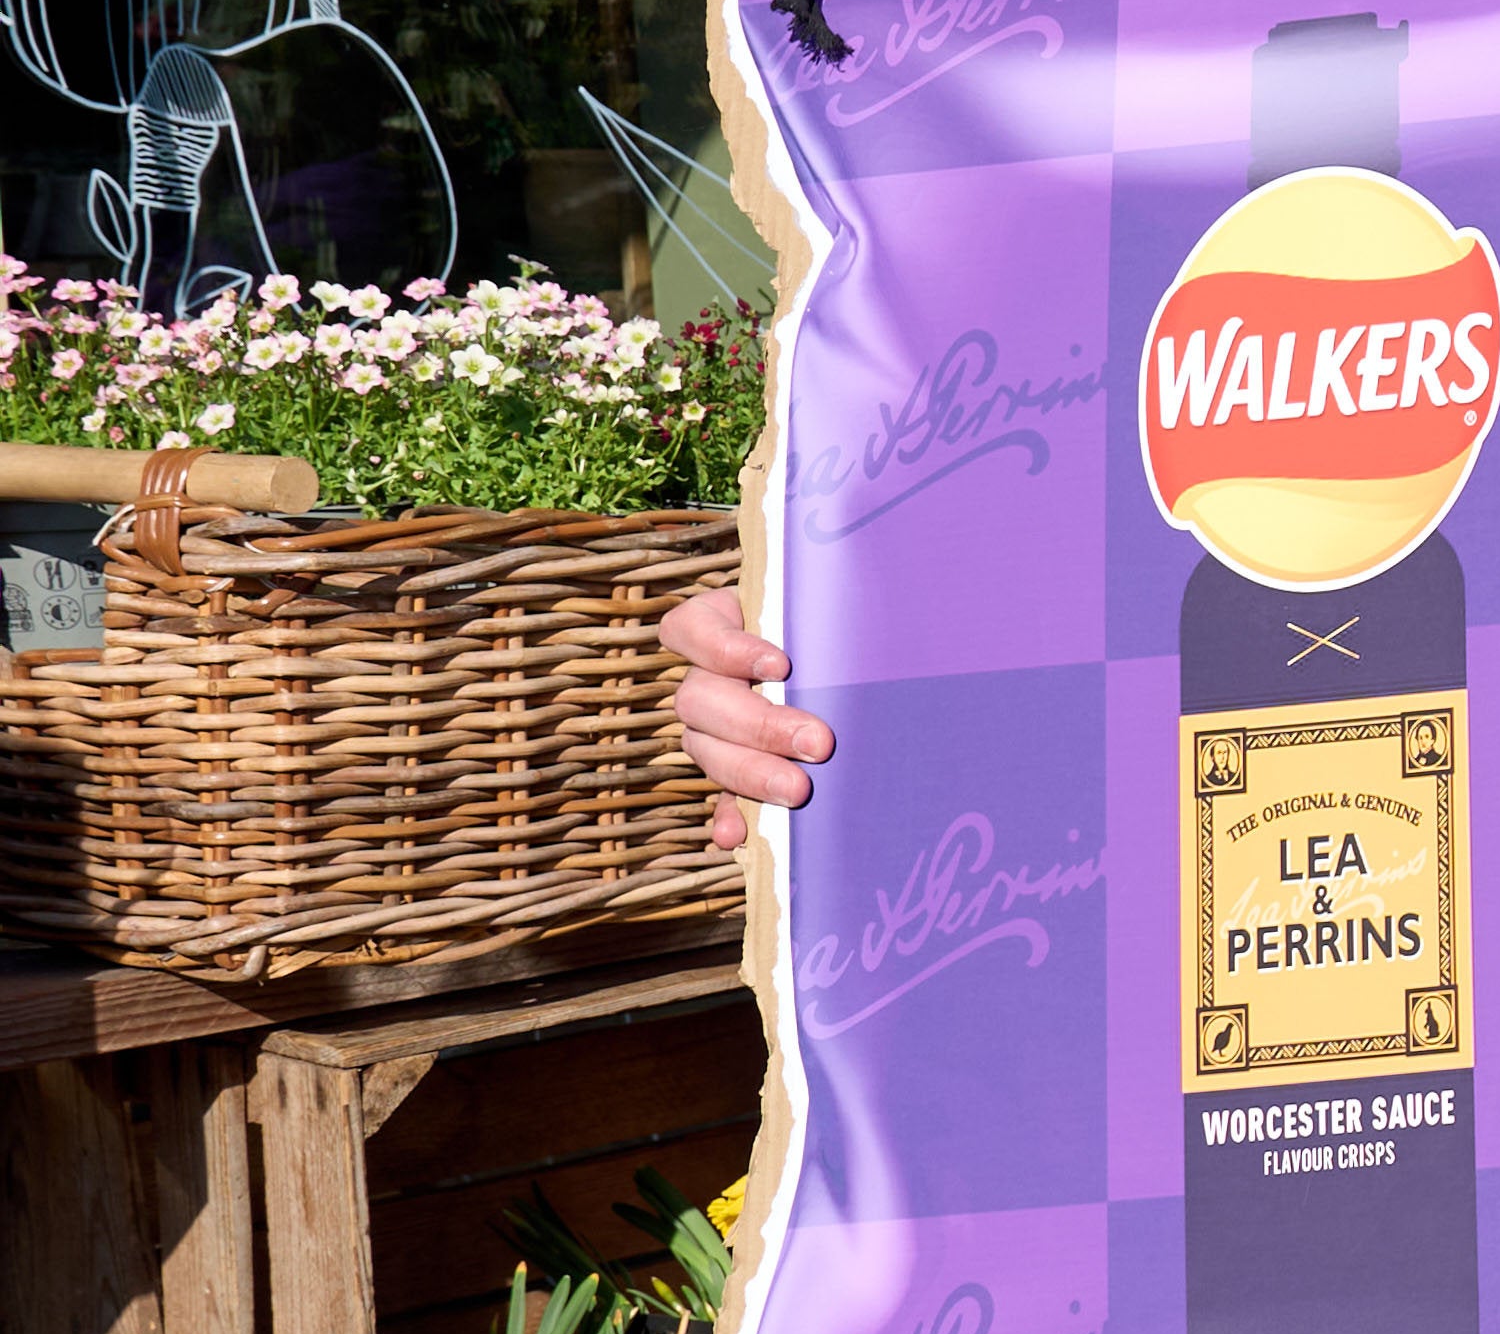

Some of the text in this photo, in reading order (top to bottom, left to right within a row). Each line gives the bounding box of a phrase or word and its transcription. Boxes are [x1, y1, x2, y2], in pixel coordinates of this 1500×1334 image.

[1156, 312, 1494, 430] WALKERS
[1226, 793, 1423, 842] THE ORIGINAL & GENUINE
[1280, 833, 1368, 882] LEA
[1312, 885, 1333, 914] &
[1228, 913, 1422, 973] PERRINS
[1202, 1089, 1456, 1146] WORCESTER SAUCE
[1263, 1140, 1396, 1176] FLAVOUR CRISPS
